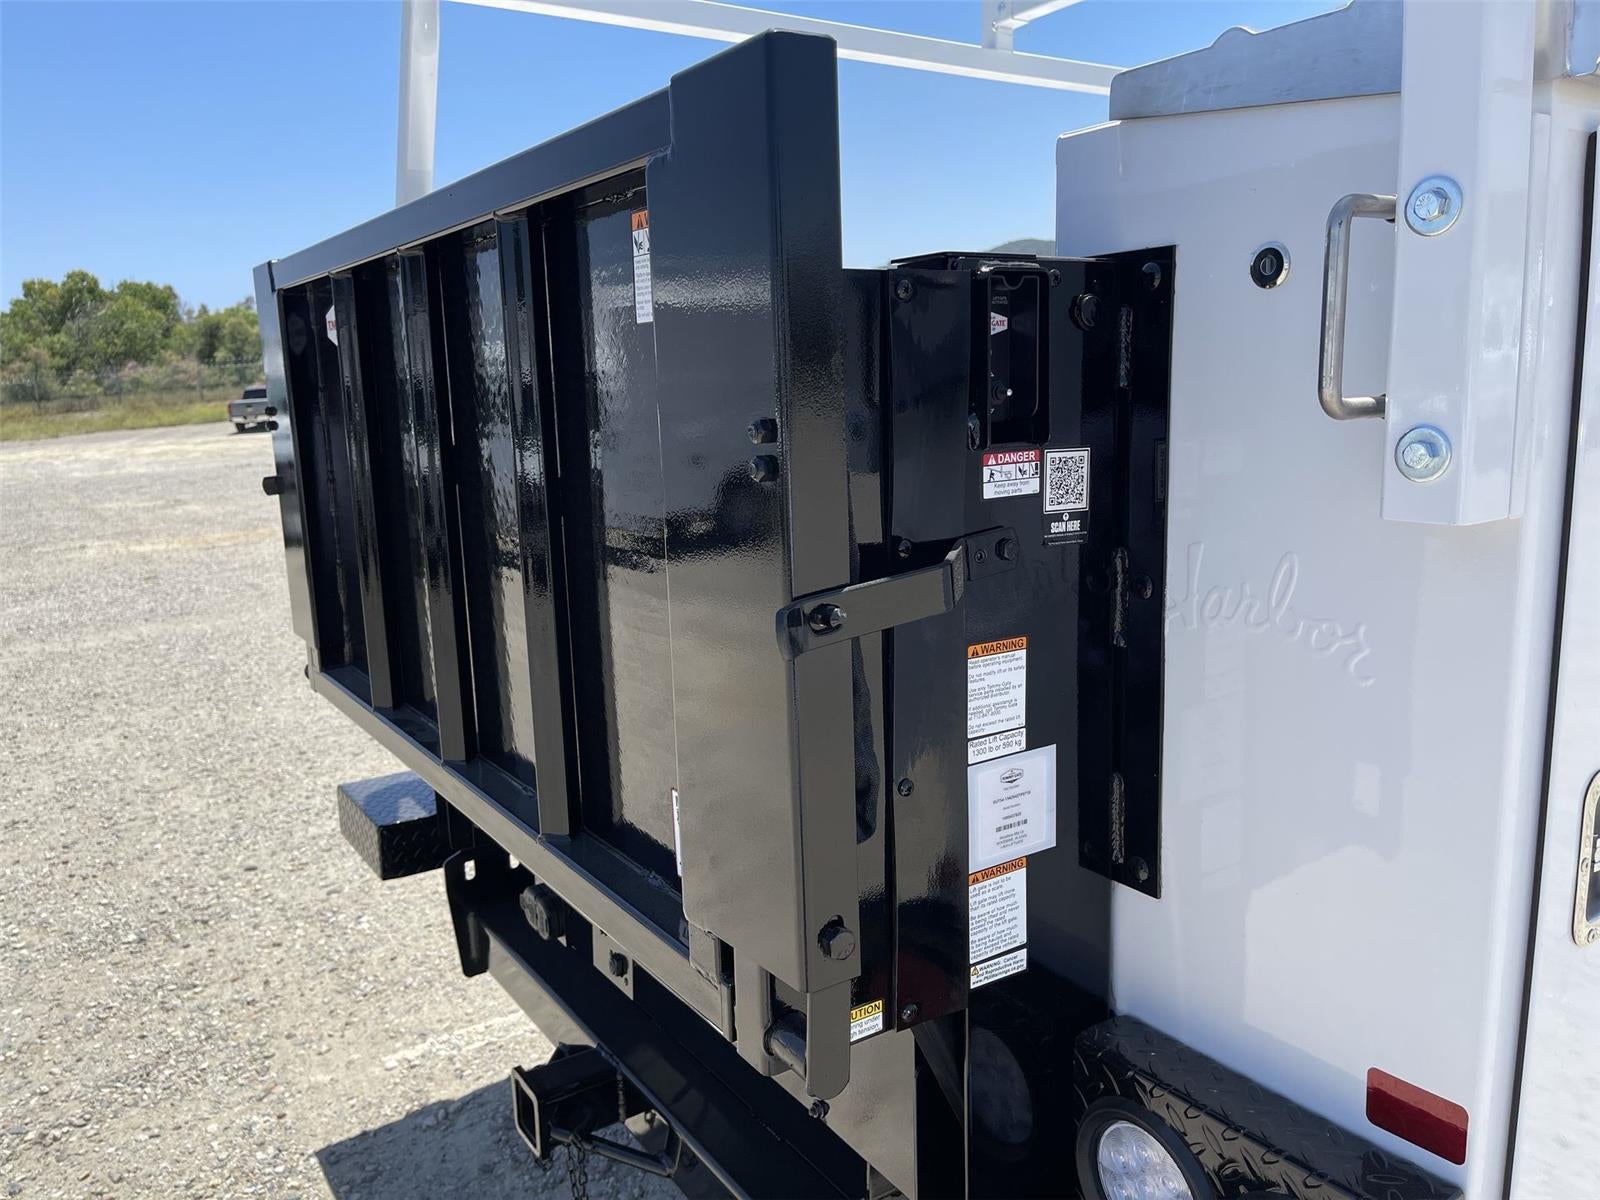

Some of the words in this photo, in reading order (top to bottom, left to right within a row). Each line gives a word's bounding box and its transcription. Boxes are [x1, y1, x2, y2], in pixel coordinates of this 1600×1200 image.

[998, 451, 1036, 463] DANGER
[1050, 522, 1066, 533] SCAN
[1066, 520, 1080, 532] HERE
[981, 639, 1024, 654] WARNING
[969, 739, 987, 748] Rated
[988, 736, 997, 744] Lift
[999, 730, 1024, 741] Capacity
[972, 746, 987, 756] 1300
[1002, 740, 1013, 749] 590
[1015, 739, 1022, 747] kg
[981, 859, 1024, 879] WARNING
[977, 884, 986, 892] gate
[1004, 954, 1017, 963] Cancer
[851, 1002, 880, 1020] UTION
